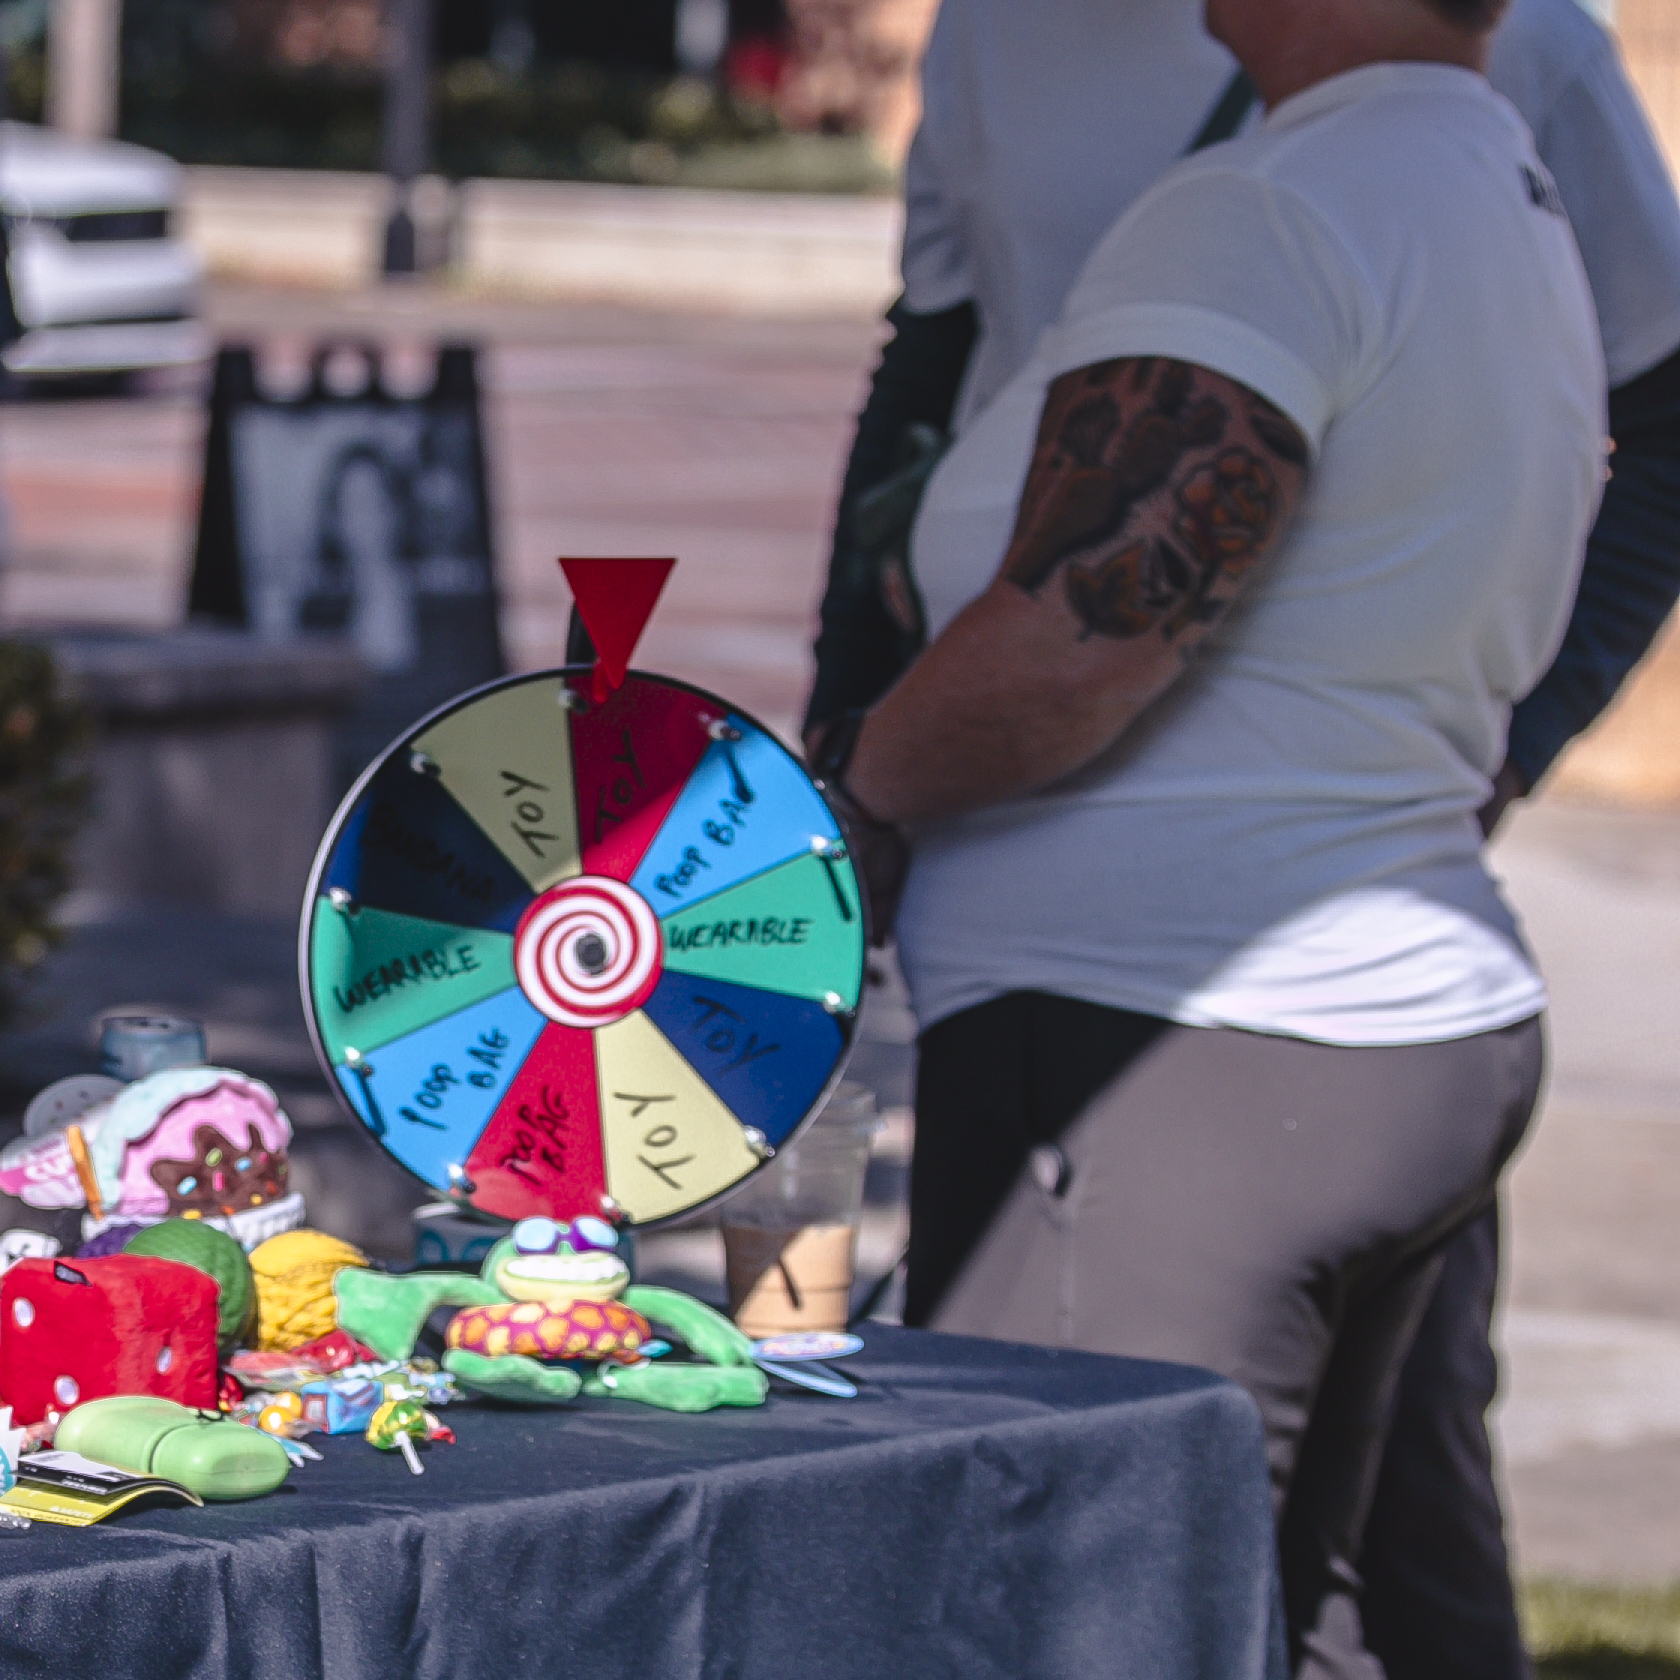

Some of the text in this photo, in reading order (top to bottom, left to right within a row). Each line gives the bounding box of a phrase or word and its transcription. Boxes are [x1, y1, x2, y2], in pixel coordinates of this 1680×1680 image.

[499, 770, 559, 858] TOY
[594, 729, 647, 843] TOY
[653, 846, 711, 898] POOP
[466, 1027, 510, 1089] BAG
[693, 995, 781, 1073] TOY
[399, 1063, 461, 1131] POOP
[613, 1091, 696, 1190] TOY
